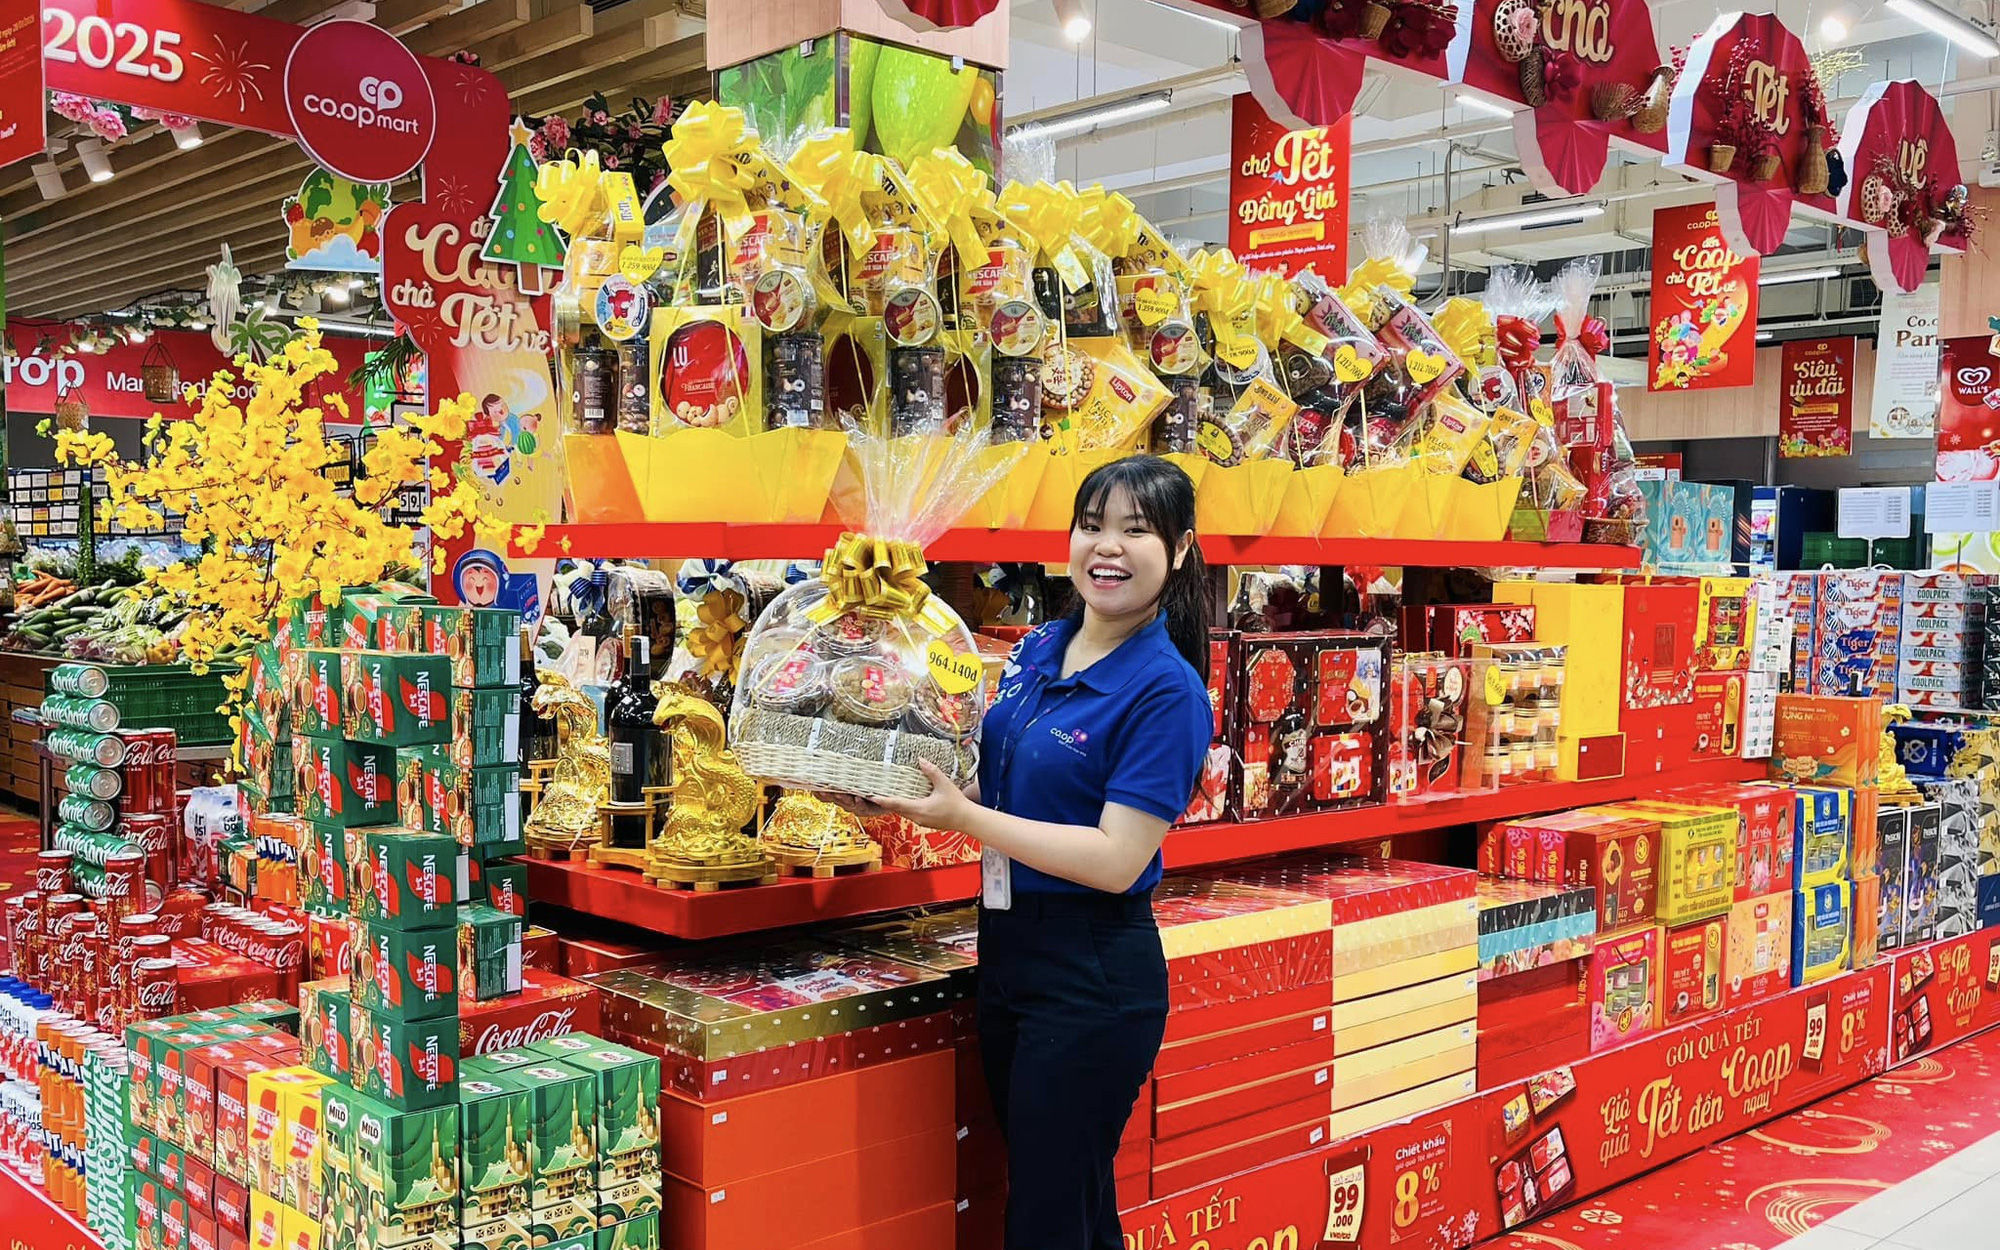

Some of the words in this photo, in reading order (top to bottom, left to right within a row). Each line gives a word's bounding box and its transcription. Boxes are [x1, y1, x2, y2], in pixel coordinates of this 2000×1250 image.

[44, 8, 184, 82] 2025
[1744, 59, 1791, 137] Tết
[1241, 152, 1271, 178] chợ
[1274, 127, 1336, 186] Tết
[1238, 190, 1298, 226] Đồng
[1295, 182, 1339, 221] Giá
[391, 279, 437, 309] chờ
[1687, 271, 1724, 297] Tết
[440, 292, 520, 351] Tết
[673, 346, 688, 367] LU
[1793, 359, 1838, 379] Siêu
[1112, 376, 1133, 402] Lipton
[1815, 376, 1846, 396] đãi
[1958, 386, 1990, 395] WALL'S
[1441, 416, 1463, 431] Lipton
[1846, 578, 1871, 592] Tiger
[1917, 589, 1950, 599] COOLPACK
[1844, 606, 1870, 620] Tiger
[1916, 619, 1949, 629] COOLPACK
[1840, 635, 1870, 651] Tiger
[1913, 648, 1946, 659] COOLPACK
[929, 651, 978, 682] 964.140d
[1911, 678, 1944, 687] COOLPACK
[140, 980, 177, 1007] Cola
[475, 1006, 577, 1056] Coca-Cola
[1665, 1040, 1695, 1067] GÓI
[1698, 1026, 1730, 1060] QUÀ
[1734, 1010, 1764, 1043] TẾT
[1809, 1017, 1823, 1037] 99
[329, 1104, 346, 1122] MILO
[1600, 1087, 1631, 1135] Giỏ
[1637, 1072, 1684, 1159] Tết
[1688, 1087, 1725, 1135] đến
[1721, 1041, 1794, 1100] Co.op
[1742, 1091, 1773, 1117] ngay
[361, 1121, 379, 1139] MILO
[1395, 1142, 1421, 1161] Chiết
[1423, 1134, 1446, 1151] khấu
[1333, 1183, 1359, 1213] 99
[1186, 1187, 1241, 1237] TẾT
[1332, 1214, 1353, 1228] .000
